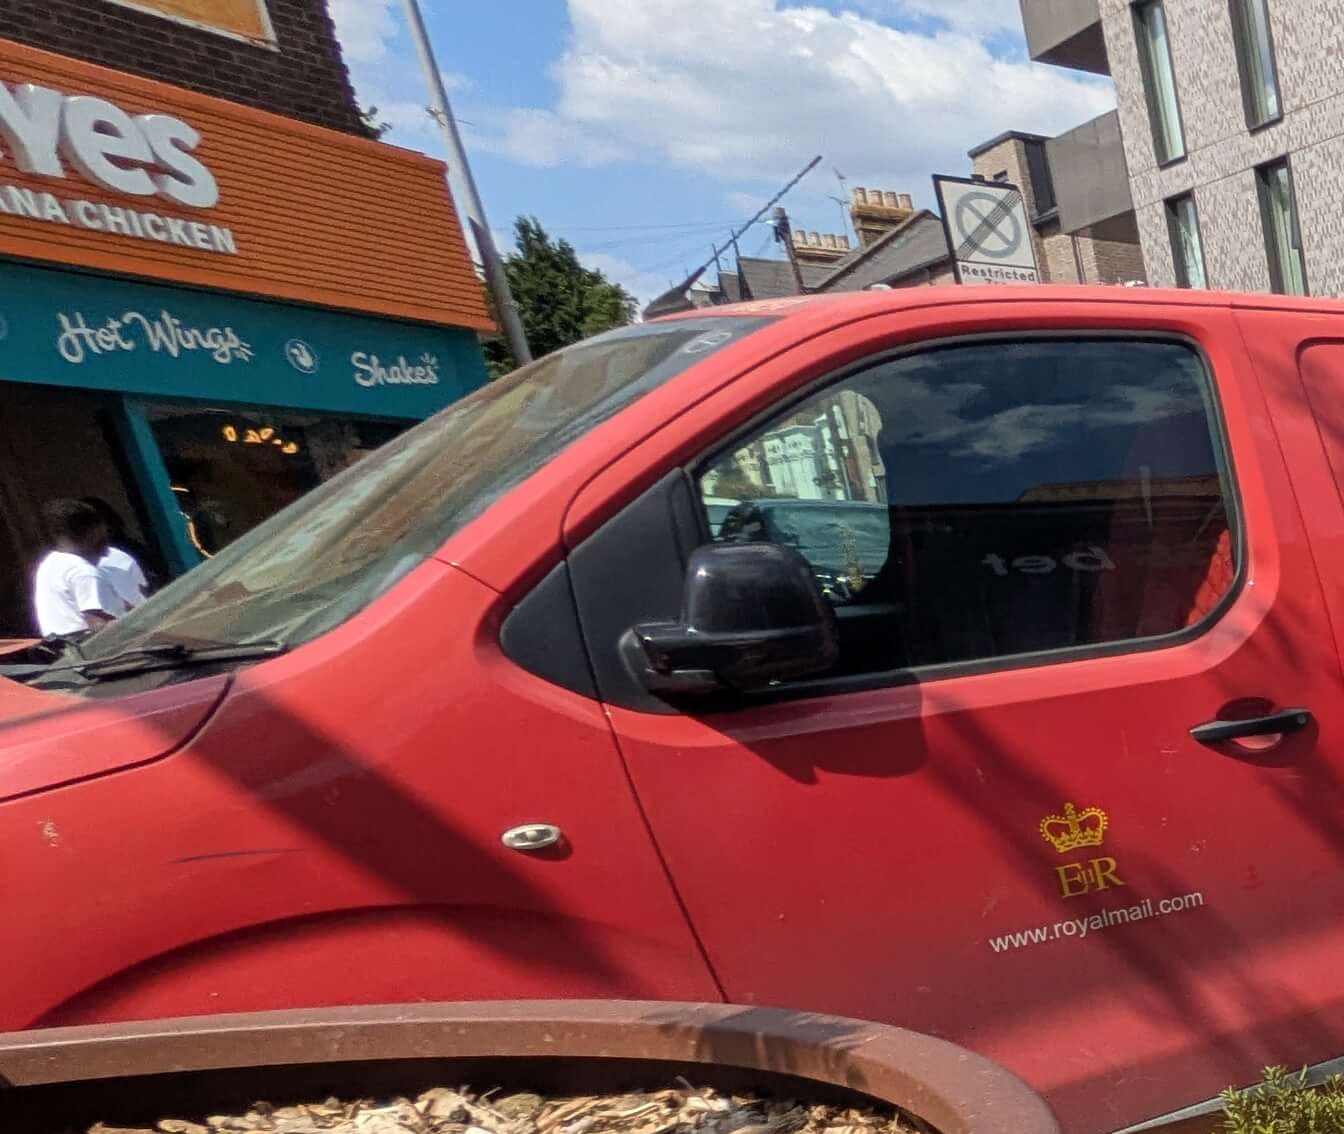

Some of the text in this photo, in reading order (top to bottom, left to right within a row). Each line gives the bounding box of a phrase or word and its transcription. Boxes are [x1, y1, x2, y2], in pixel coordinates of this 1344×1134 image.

[74, 199, 240, 256] CHICKEN
[961, 264, 1036, 282] Restricted
[57, 310, 241, 364] Hot Wings
[352, 352, 440, 386] Shakes
[989, 892, 1204, 954] www.royalmail.com
